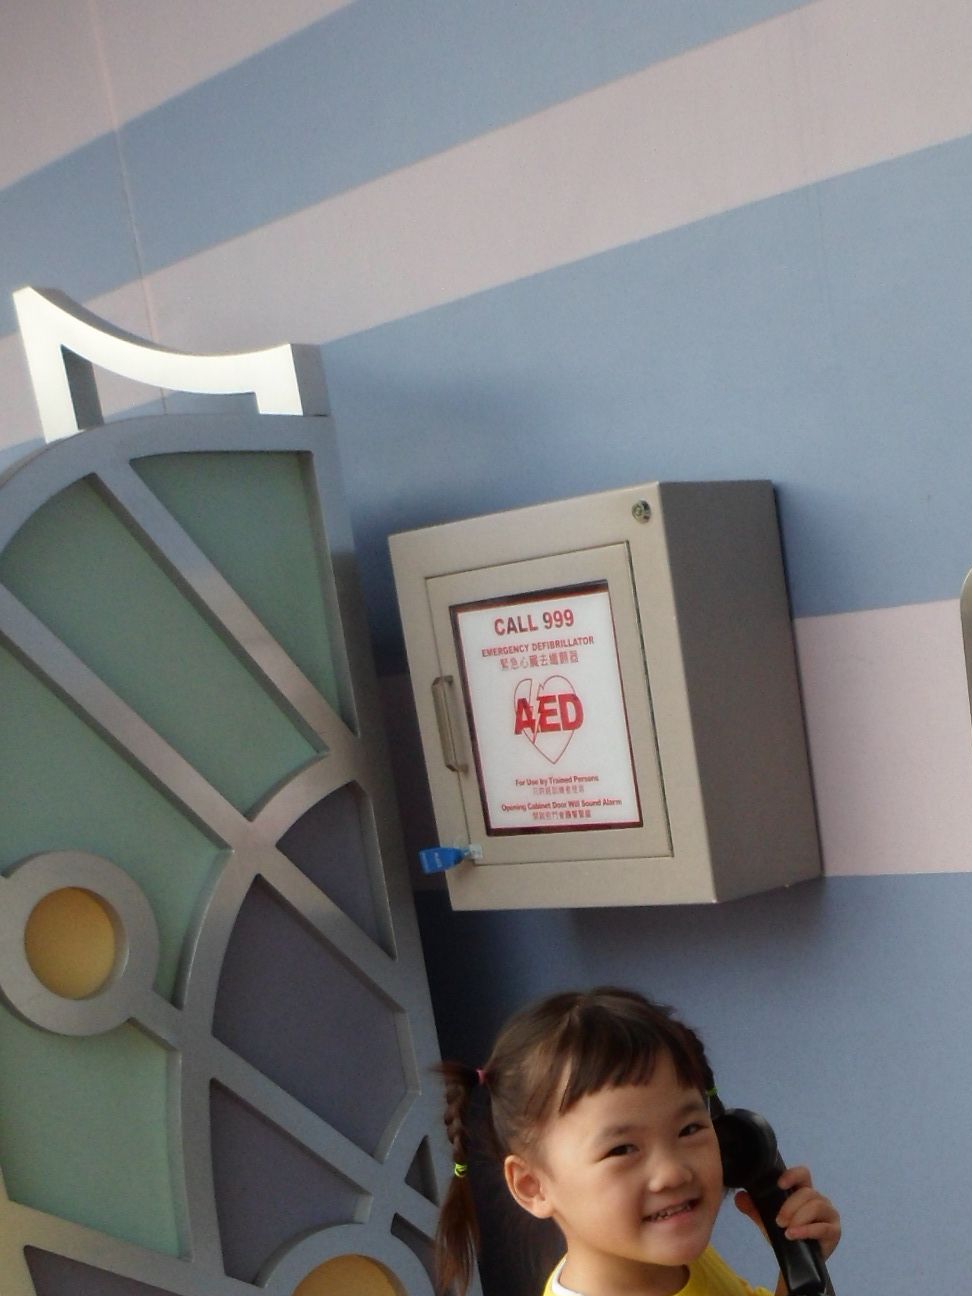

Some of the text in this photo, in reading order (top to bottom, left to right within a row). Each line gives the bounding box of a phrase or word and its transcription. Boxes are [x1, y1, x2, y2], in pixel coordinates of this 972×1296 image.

[494, 609, 575, 636] CALL 999
[481, 636, 595, 658] EMERGENCY DEFIBRILLATOR
[513, 692, 585, 736] AED
